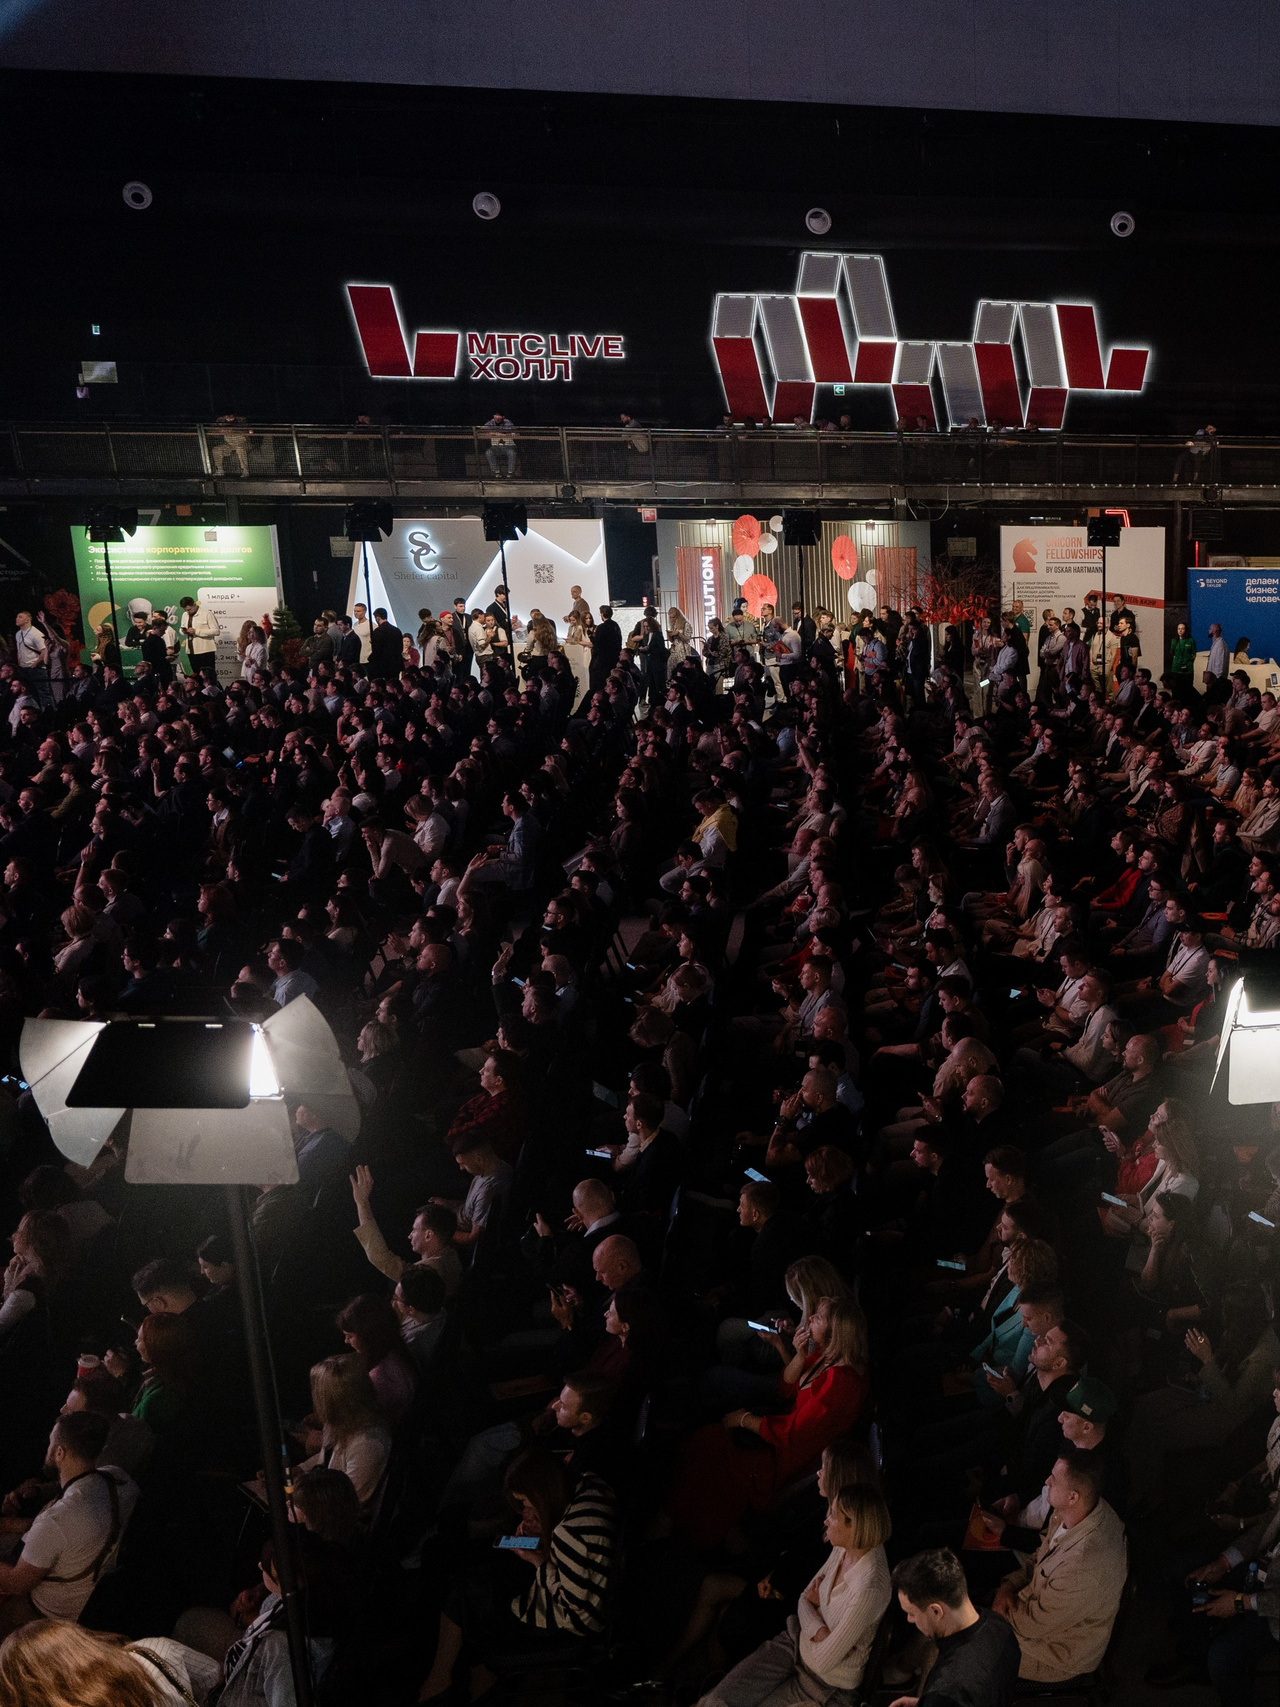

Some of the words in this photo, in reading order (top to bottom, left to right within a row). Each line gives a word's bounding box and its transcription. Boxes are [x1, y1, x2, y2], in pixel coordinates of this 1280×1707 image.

[550, 334, 624, 358] LIVE
[470, 357, 572, 381] ХОЛЛ
[1046, 537, 1082, 547] UNICORN
[146, 546, 218, 556] корпоративных
[1046, 549, 1103, 559] FELLOWSHIPS
[1046, 566, 1053, 574] BY
[1054, 566, 1072, 574] OSKAR
[1072, 566, 1103, 574] HARTMANN
[394, 571, 423, 580] Shefer
[426, 571, 458, 581] capital
[1245, 578, 1279, 586] делаем
[1245, 586, 1278, 594] бизнес
